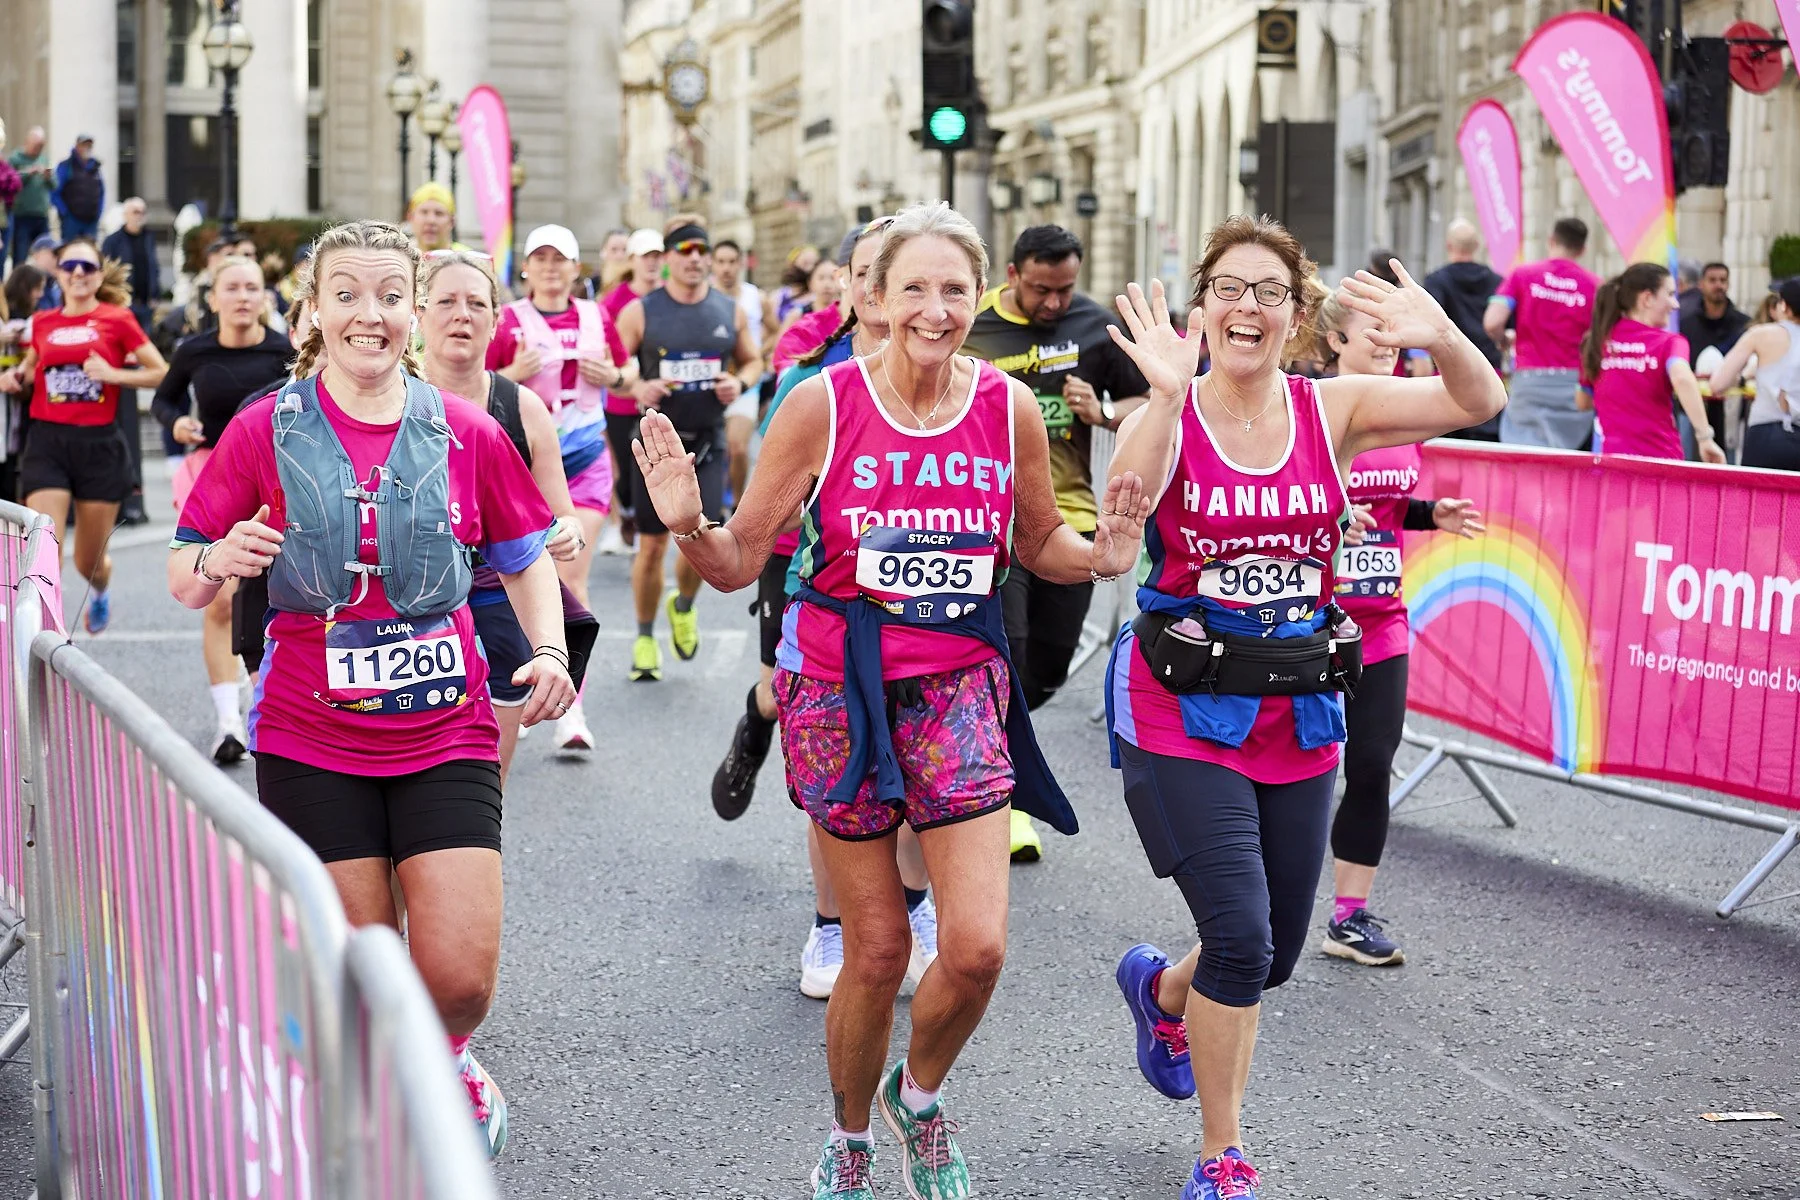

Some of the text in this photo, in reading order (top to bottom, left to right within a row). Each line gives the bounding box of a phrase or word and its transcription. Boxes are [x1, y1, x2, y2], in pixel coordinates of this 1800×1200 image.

[1530, 282, 1586, 307] Tommy's
[1543, 271, 1578, 291] Team
[1600, 354, 1658, 373] ommy's
[851, 451, 1012, 495] STACEY
[1349, 465, 1418, 491] ommy's
[1182, 480, 1329, 518] HANNAH
[841, 503, 1001, 540] Tommy's
[907, 533, 954, 546] STACEY
[1180, 526, 1332, 557] Tommy's
[878, 555, 974, 590] 9635
[1343, 550, 1397, 573] 1653
[1219, 563, 1306, 597] 9634
[1634, 541, 1800, 636] Tomm
[376, 622, 415, 636] LAURA
[338, 641, 456, 684] 11260
[1628, 644, 1656, 669] The
[1658, 654, 1744, 689] pregnancy
[1748, 666, 1781, 690] and
